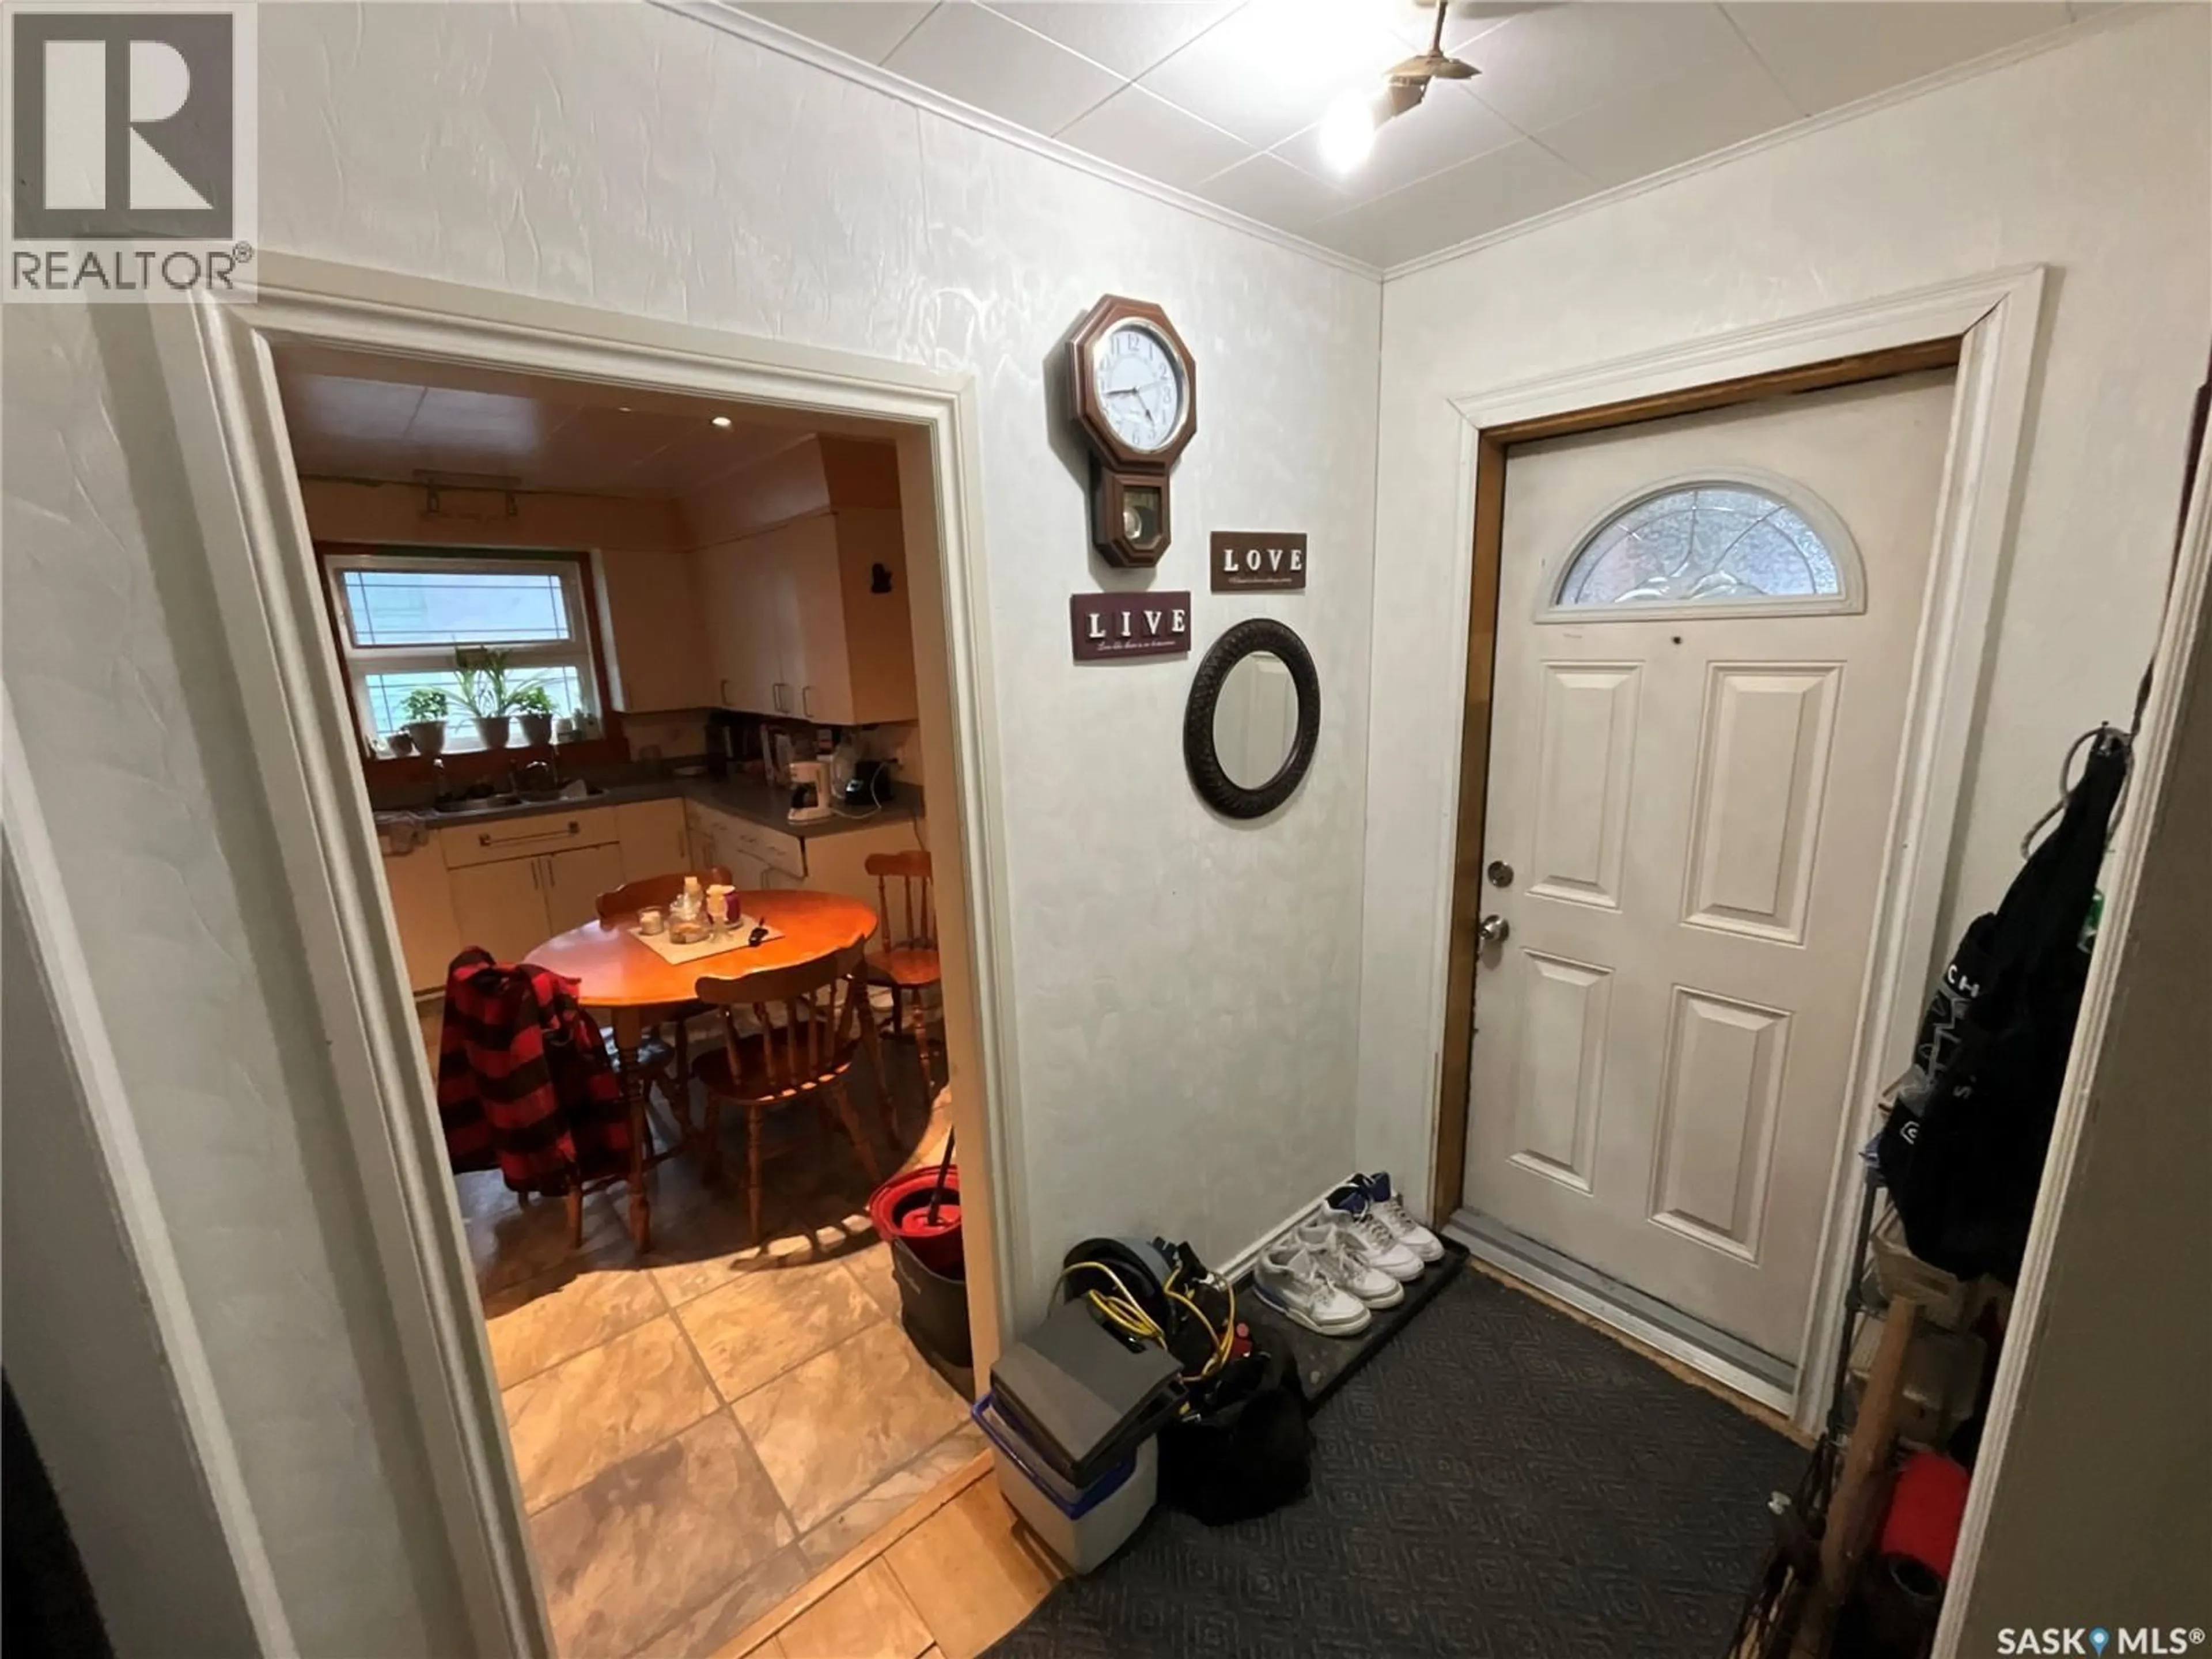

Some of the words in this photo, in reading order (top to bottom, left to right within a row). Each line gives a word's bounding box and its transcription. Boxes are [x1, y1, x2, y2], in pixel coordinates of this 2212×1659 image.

[1127, 333, 1141, 351] 12
[1158, 362, 1168, 381] 2
[1223, 548, 1302, 573] LOVE
[1089, 609, 1186, 638] LIVE
